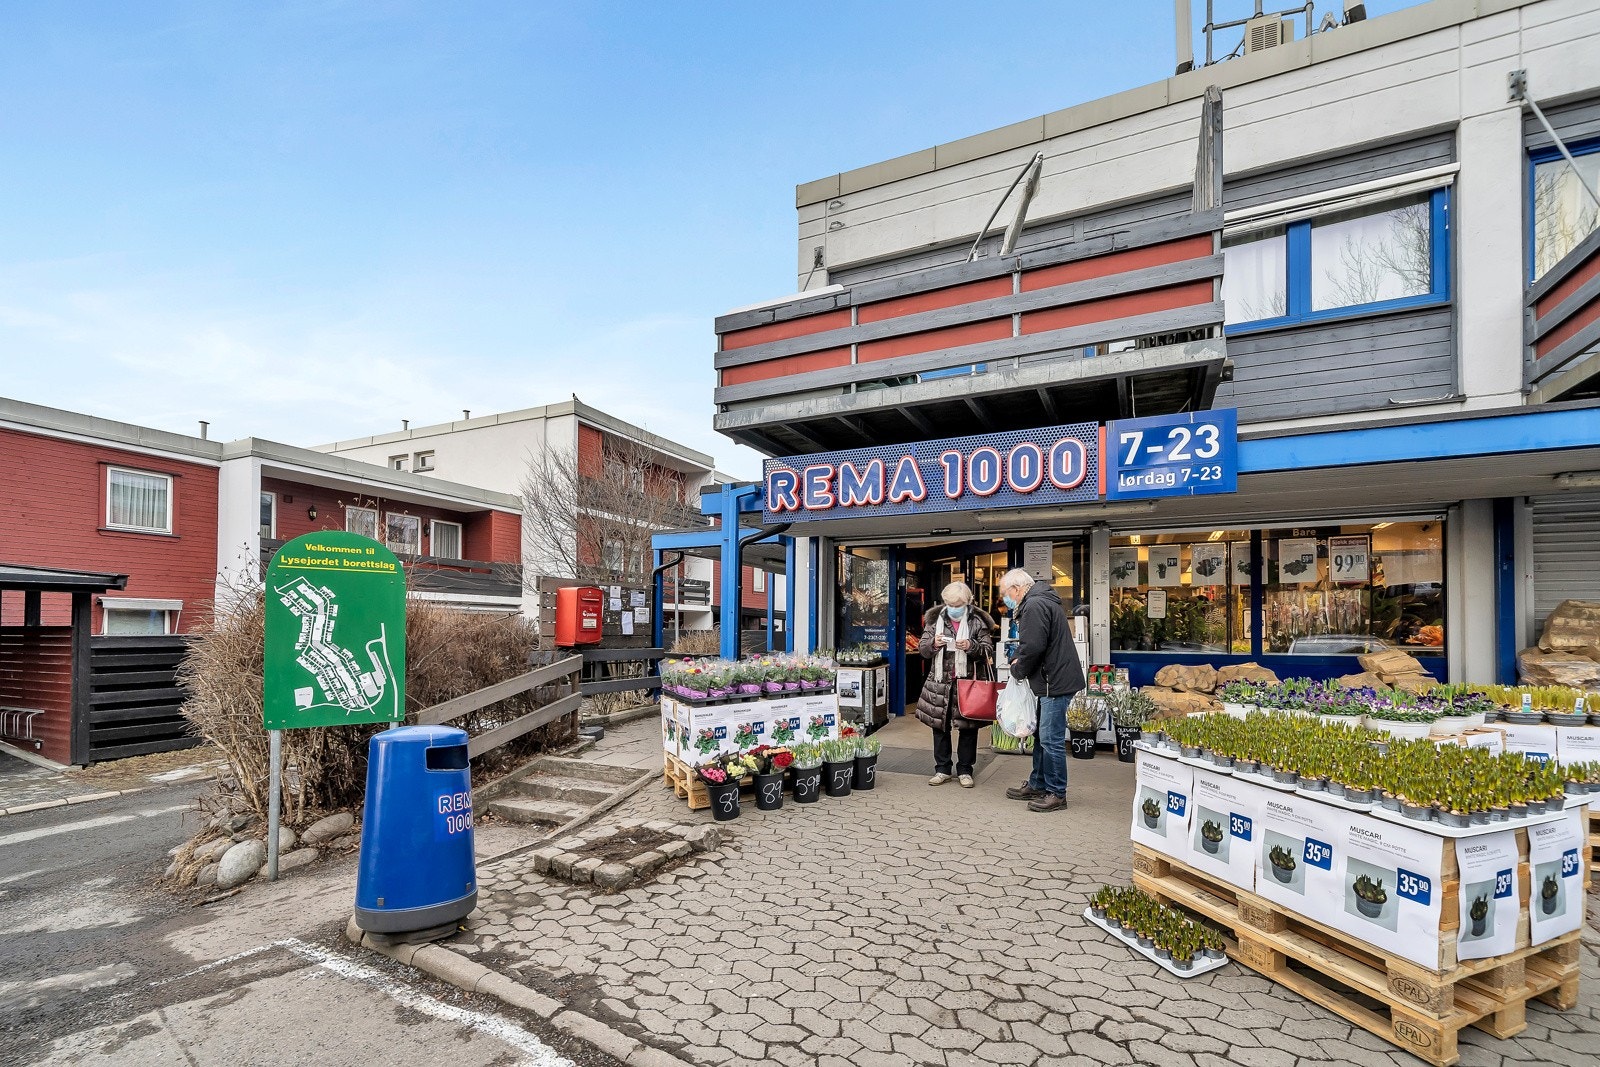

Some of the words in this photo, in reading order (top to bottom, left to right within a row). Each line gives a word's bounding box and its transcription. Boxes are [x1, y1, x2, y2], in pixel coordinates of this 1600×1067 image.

[1119, 424, 1221, 466] 7-23
[768, 455, 927, 513] REMA
[940, 437, 1087, 499] 1000
[1120, 467, 1176, 487] lørdag
[1180, 465, 1222, 482] 7-23
[1292, 528, 1316, 536] Bare
[305, 543, 362, 554] Velkommen
[365, 547, 374, 555] til
[281, 555, 339, 566] Lysejordet
[343, 558, 395, 570] borettslag
[1142, 761, 1160, 771] MUSCARI
[1200, 780, 1220, 790] MUSCARI
[1267, 801, 1293, 813] MUSCARI
[1349, 826, 1382, 840] MUSCARI
[1464, 845, 1488, 854] MUSCARI
[1397, 980, 1424, 1002] EPAL
[1399, 1023, 1425, 1045] EPAL
